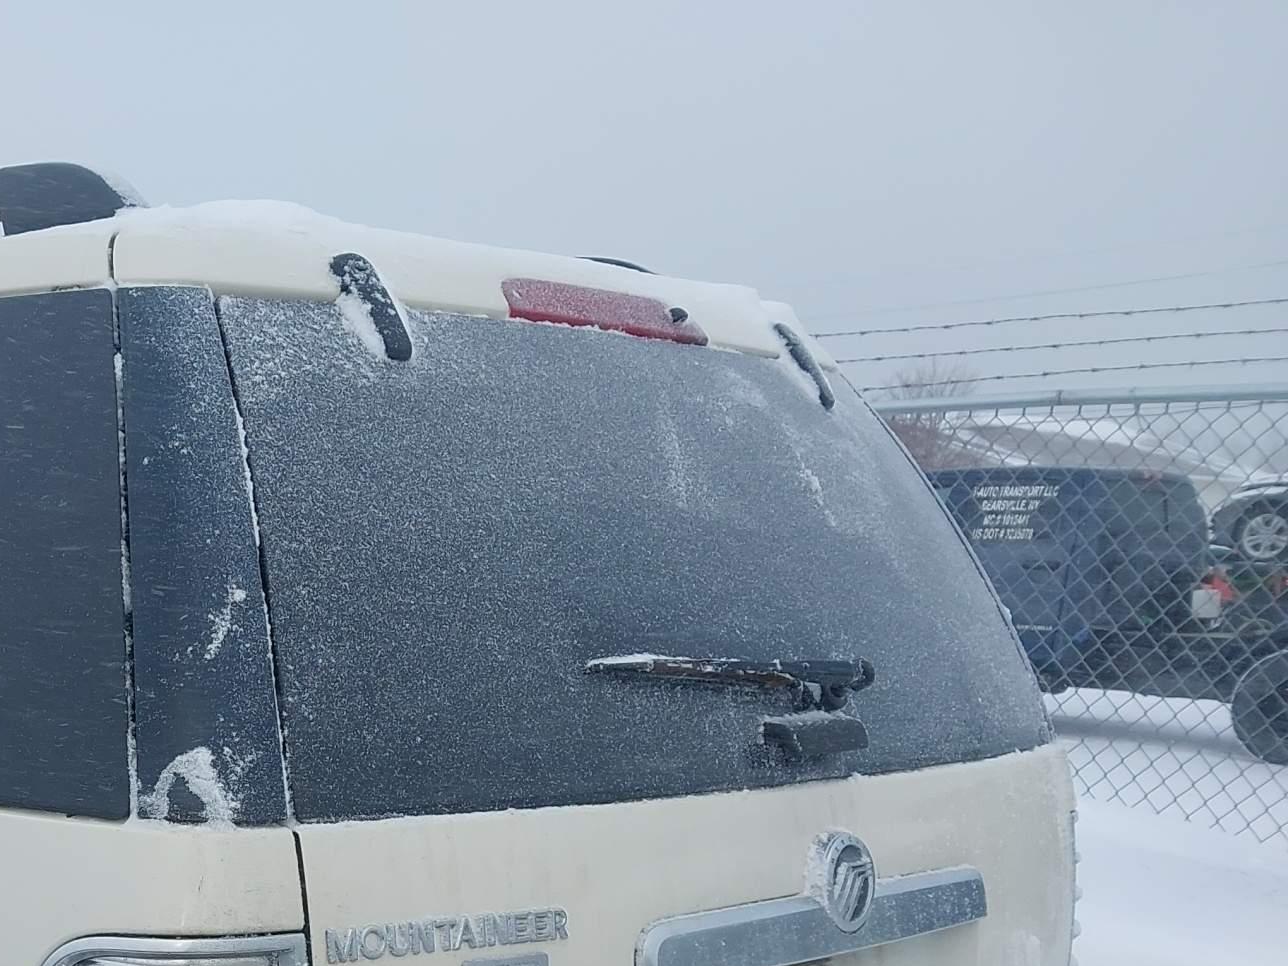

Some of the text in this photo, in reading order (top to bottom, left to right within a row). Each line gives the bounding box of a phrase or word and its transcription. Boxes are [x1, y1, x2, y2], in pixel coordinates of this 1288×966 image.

[999, 485, 1044, 498] TRANSPORT
[983, 527, 1000, 539] DOT
[324, 908, 569, 964] MOUNTAINEER
